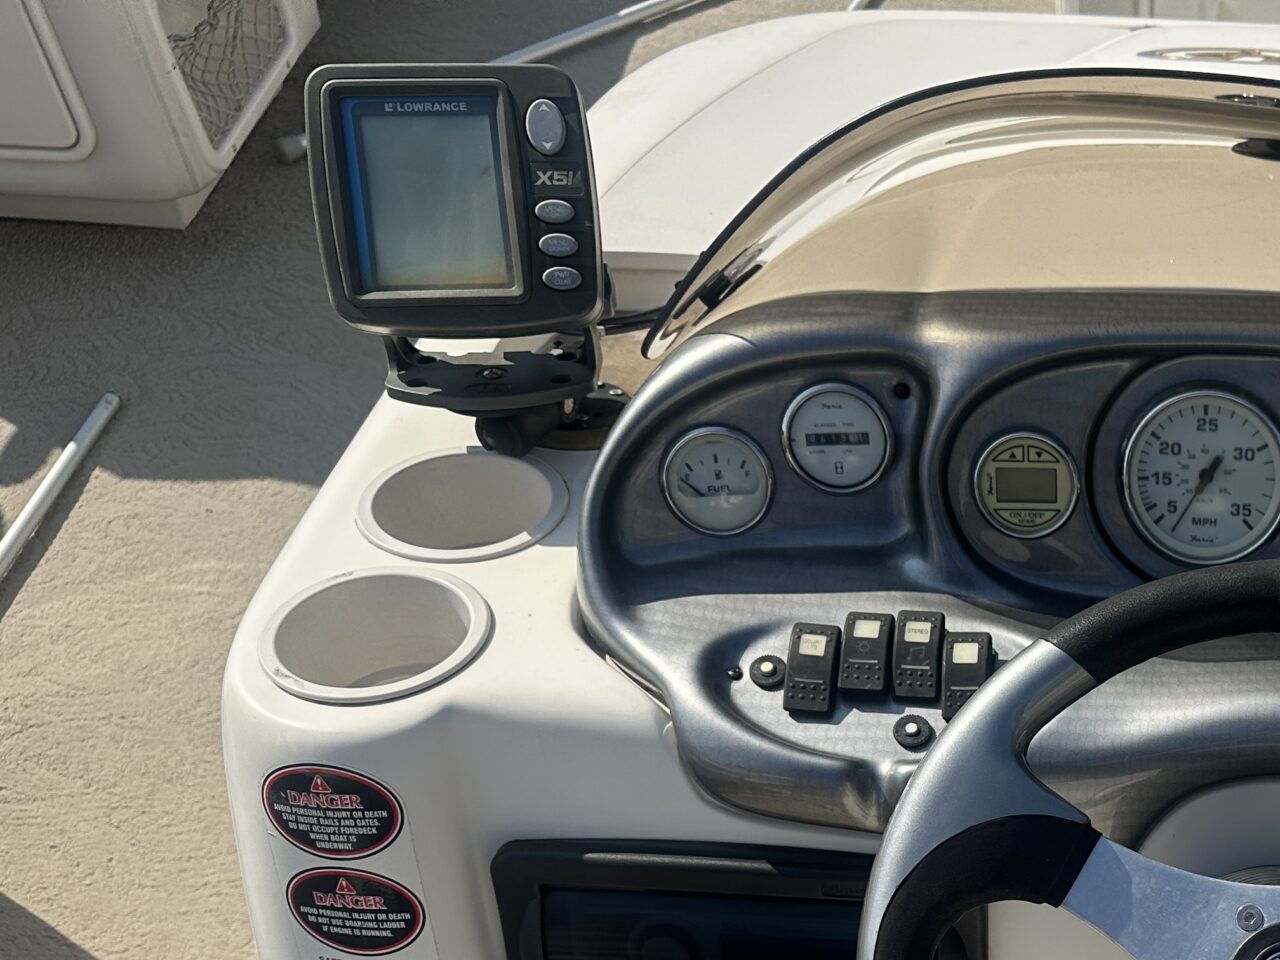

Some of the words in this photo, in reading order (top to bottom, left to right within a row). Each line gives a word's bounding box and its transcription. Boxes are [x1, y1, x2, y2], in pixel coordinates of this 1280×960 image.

[397, 102, 467, 112] LOWRANCE
[1196, 419, 1219, 432] 25
[1159, 441, 1182, 456] 20
[1233, 447, 1255, 461] 30
[1152, 472, 1172, 486] 15
[706, 485, 733, 493] FUEL
[1167, 500, 1178, 514] 5
[1230, 503, 1252, 517] 35
[1192, 517, 1217, 527] MPH
[287, 790, 364, 809] DANGER
[274, 803, 291, 813] AVOID
[292, 807, 325, 817] PERSONAL
[326, 810, 351, 818] INJURY
[281, 812, 296, 821] STAY
[297, 815, 318, 824] INSIDE
[320, 818, 339, 826] RAILS
[288, 821, 297, 829] DO
[298, 823, 311, 831] NOT
[312, 825, 339, 834] OCCUPY
[309, 833, 329, 841] WHEN
[312, 891, 388, 909] DANGER
[300, 905, 318, 914] AVOID
[319, 909, 351, 919] PERSONAL
[352, 912, 375, 920] INJURY
[318, 916, 330, 924] NOT
[331, 918, 344, 926] USE
[345, 920, 378, 928] BOARDING
[380, 921, 406, 929] LADDER
[330, 926, 353, 935] ENGINE
